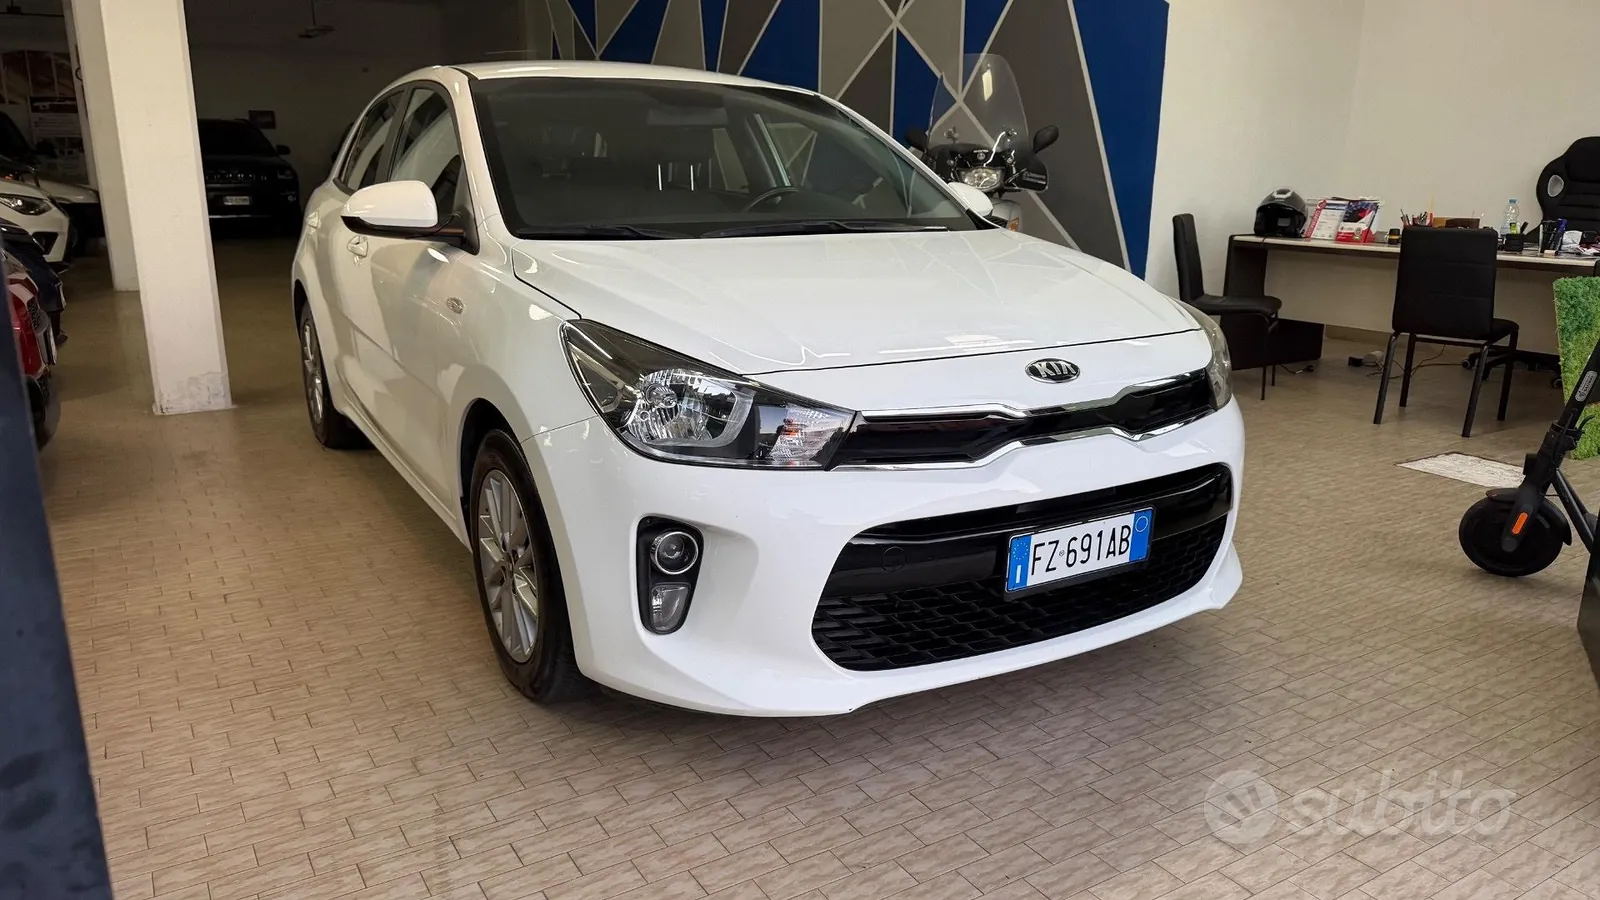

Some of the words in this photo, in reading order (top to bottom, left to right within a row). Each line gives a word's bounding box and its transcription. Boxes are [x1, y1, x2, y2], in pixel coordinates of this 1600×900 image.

[1034, 360, 1077, 378] KIA
[1030, 539, 1060, 576] FZ
[1065, 524, 1132, 568] 691AB
